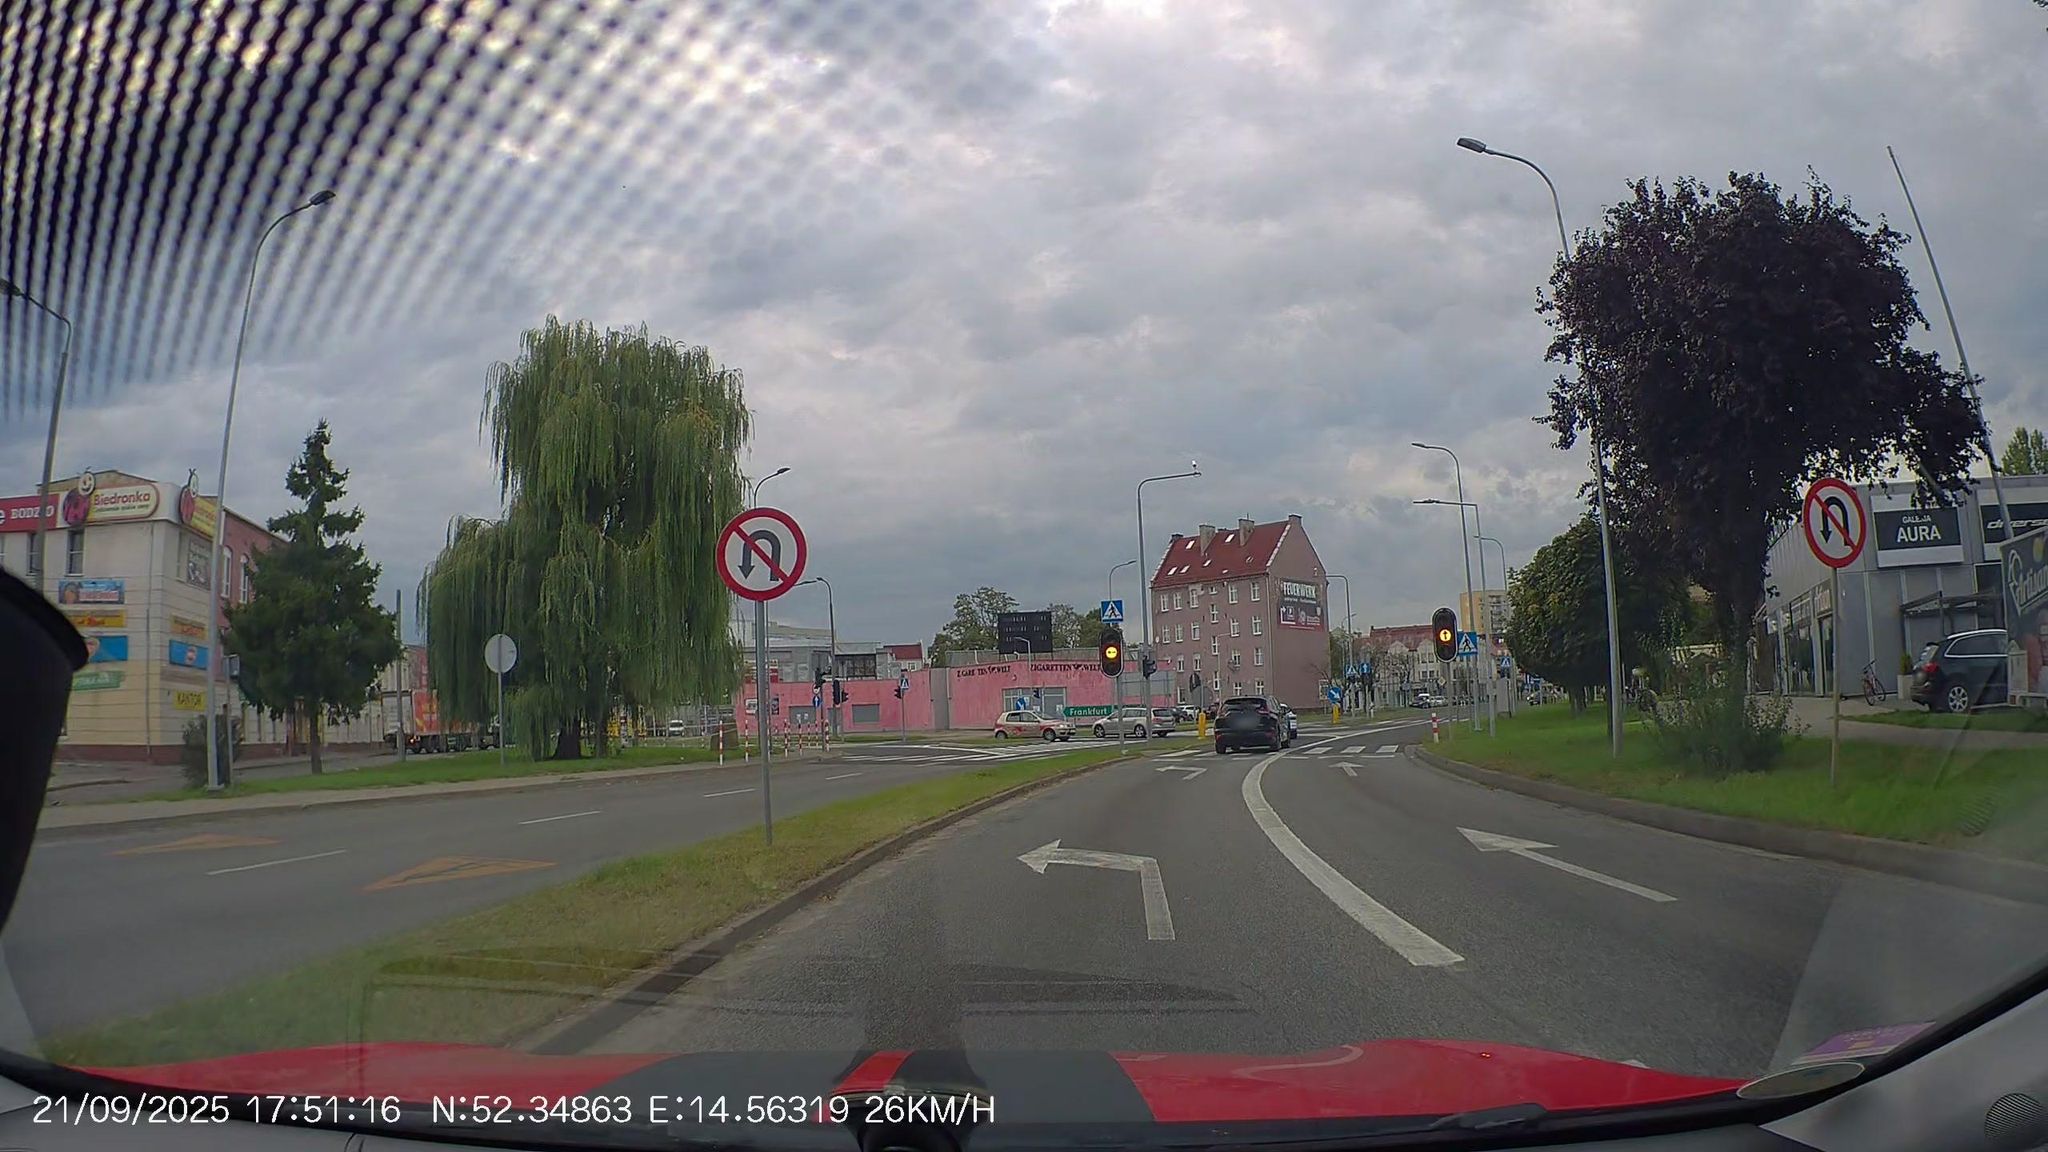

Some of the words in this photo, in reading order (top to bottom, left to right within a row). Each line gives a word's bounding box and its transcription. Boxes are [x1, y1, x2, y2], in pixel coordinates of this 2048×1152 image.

[94, 491, 151, 506] Biedronka
[10, 505, 55, 519] BODZO
[1896, 525, 1942, 543] AURA
[1069, 707, 1108, 717] Frankfurt
